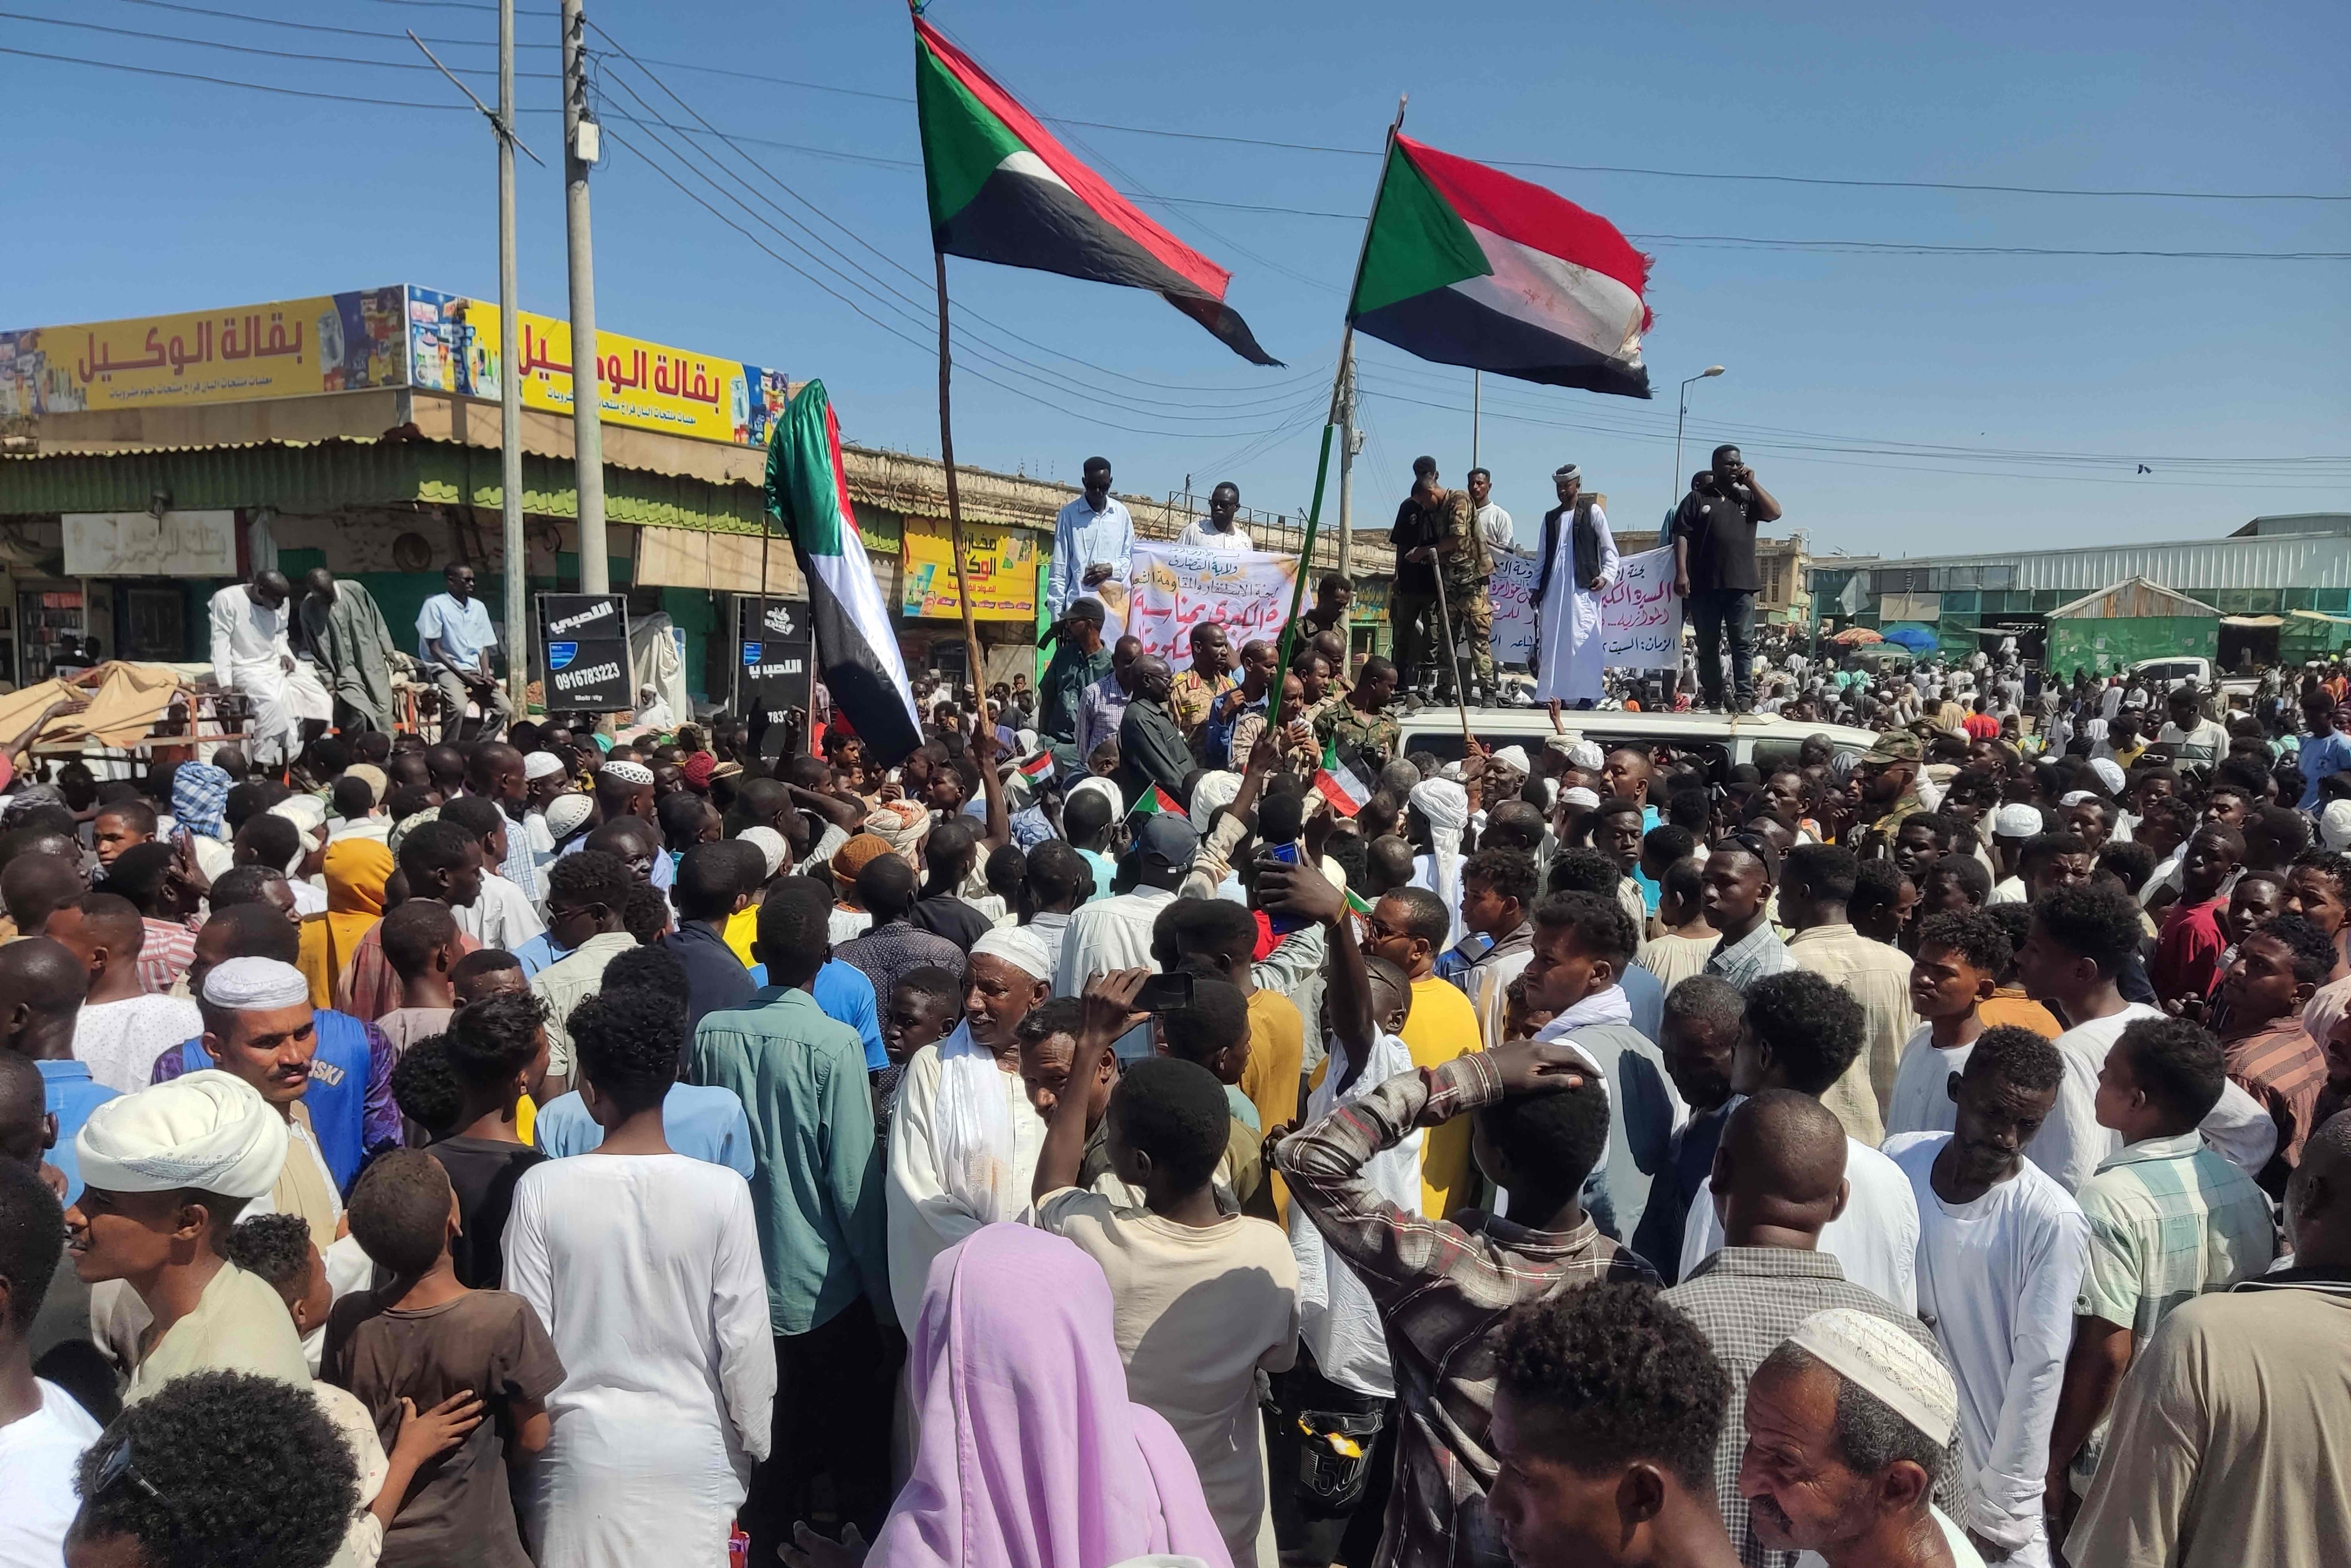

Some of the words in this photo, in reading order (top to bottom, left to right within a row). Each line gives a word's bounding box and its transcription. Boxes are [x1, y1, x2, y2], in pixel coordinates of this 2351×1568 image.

[221, 312, 302, 364] بقالة
[79, 320, 212, 383] الوكيل
[518, 324, 646, 393] الويل
[655, 355, 719, 414] بقالة
[1168, 555, 1210, 571] القضارف
[1212, 561, 1238, 576] ولاية
[1627, 564, 1645, 578] لجنة
[1255, 584, 1278, 600] لجنة
[1609, 637, 1638, 654] السبت
[555, 662, 620, 691] 0916783223
